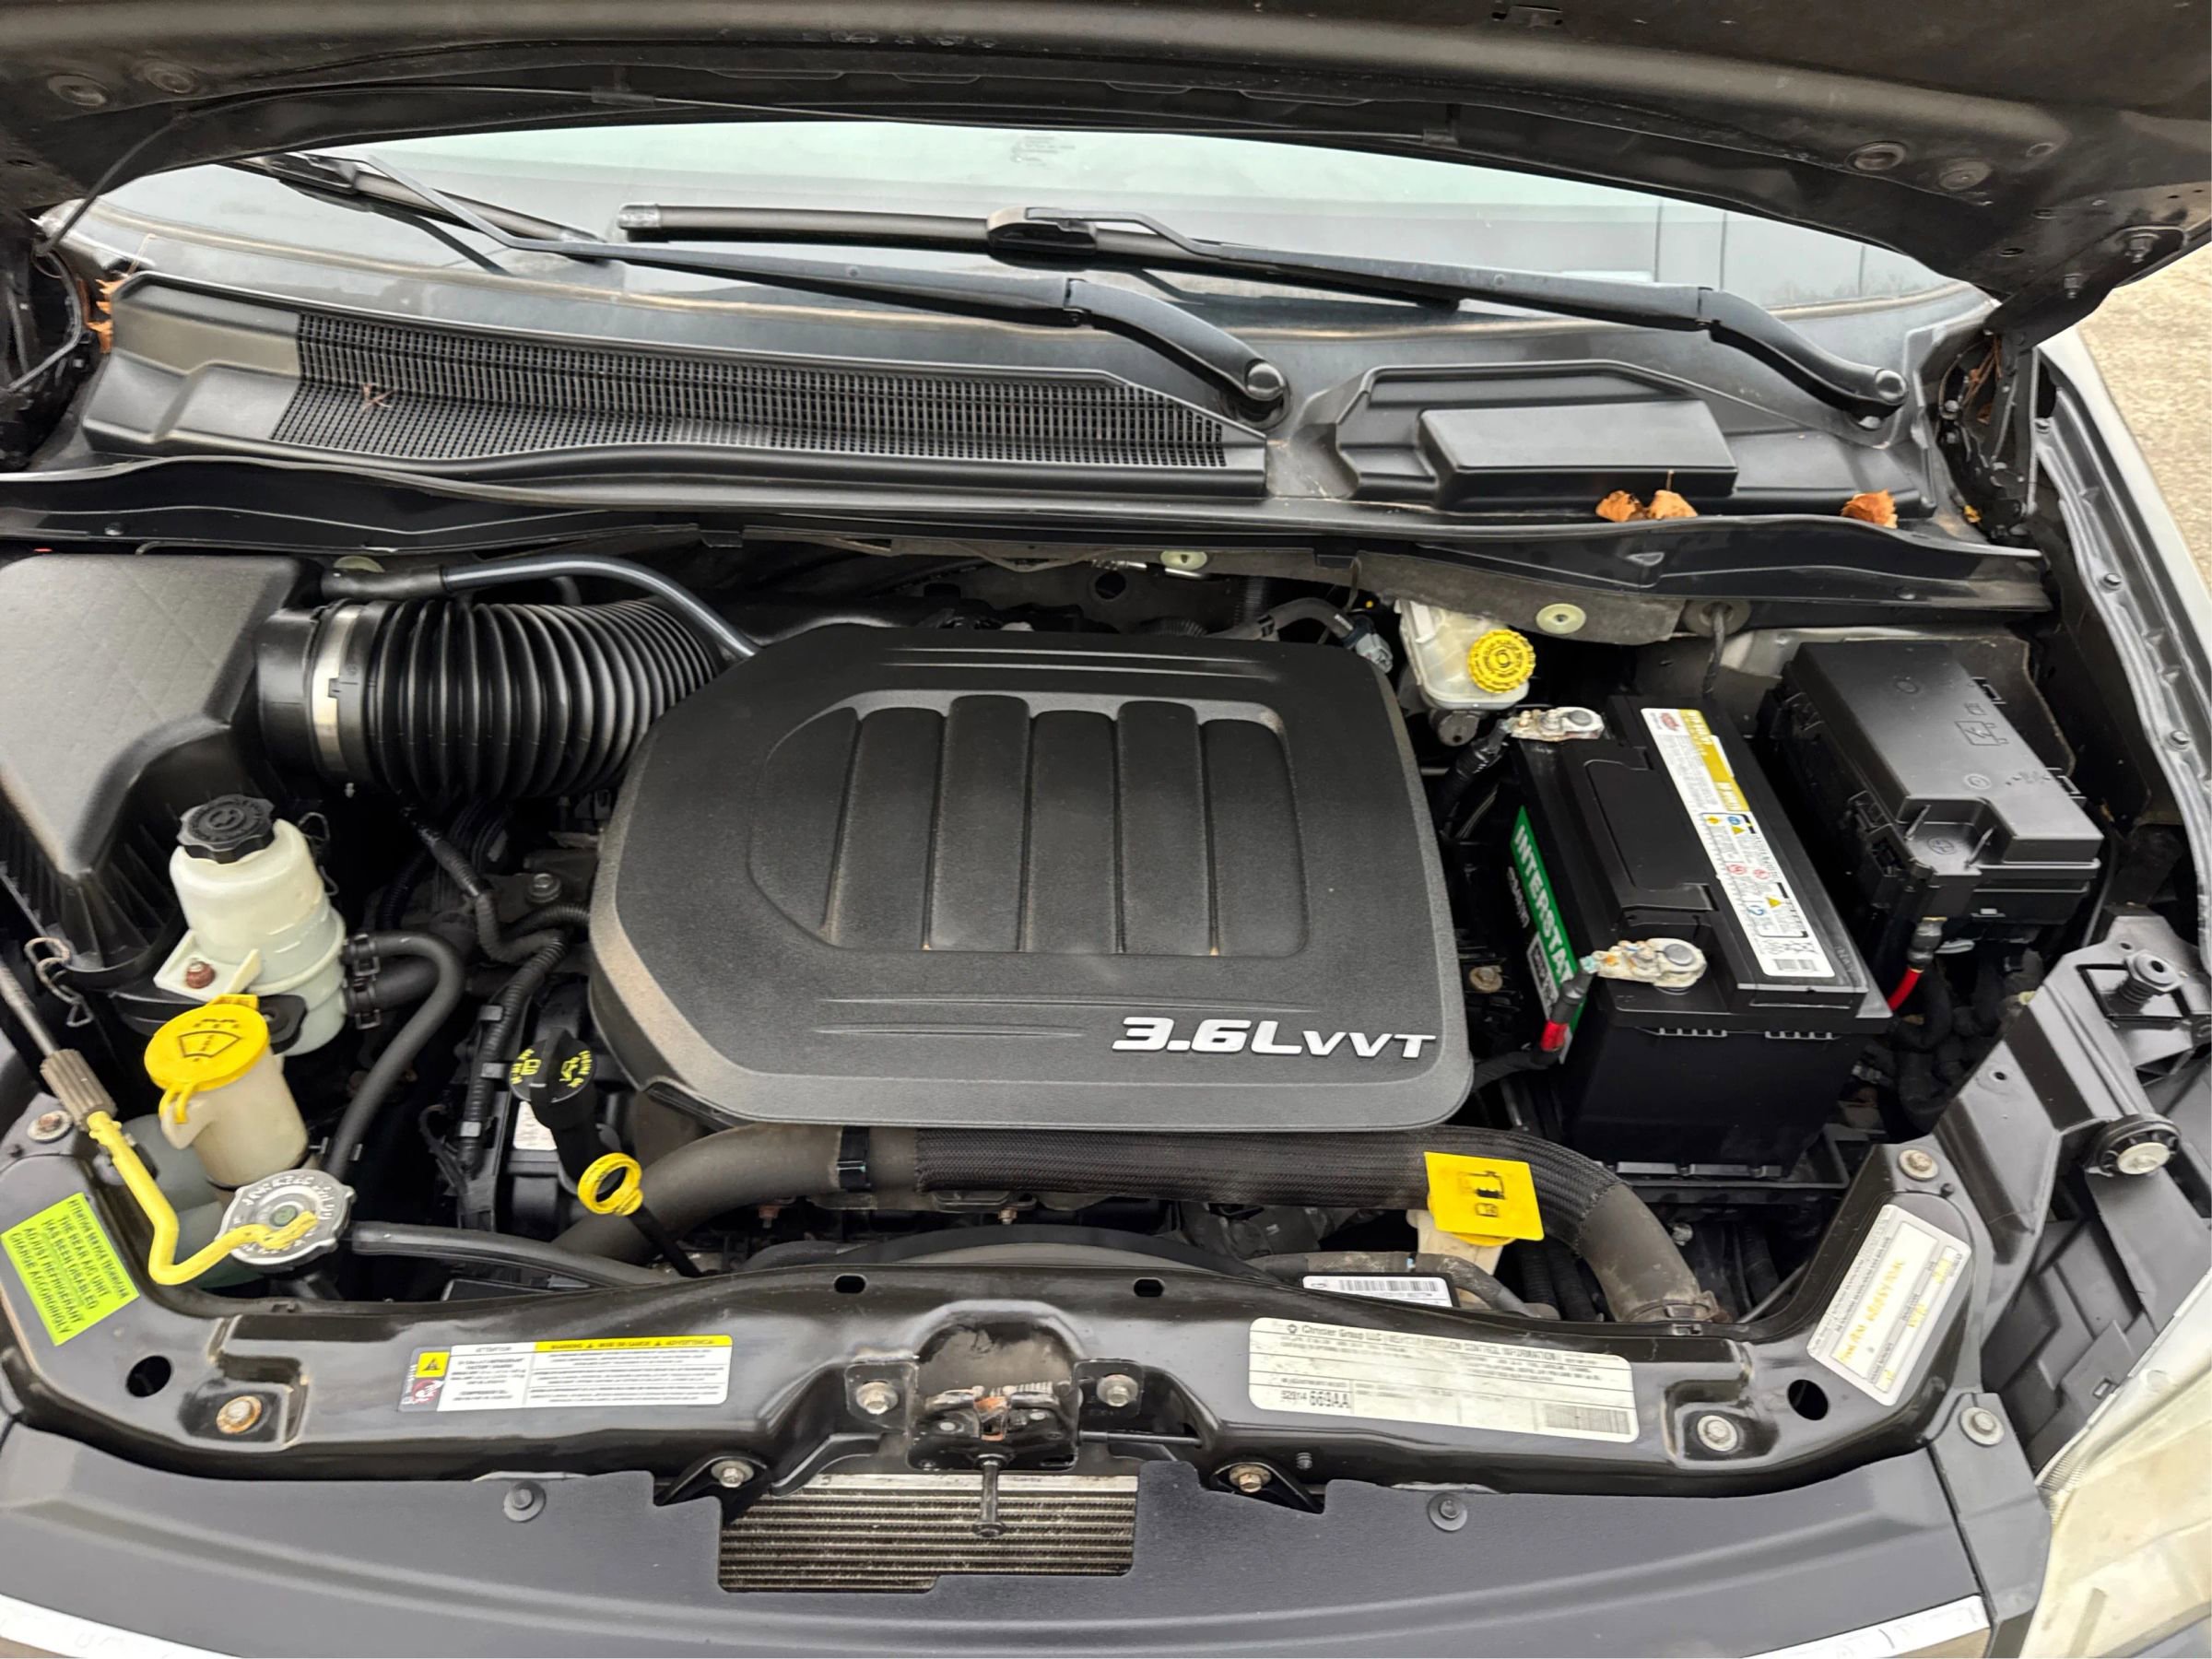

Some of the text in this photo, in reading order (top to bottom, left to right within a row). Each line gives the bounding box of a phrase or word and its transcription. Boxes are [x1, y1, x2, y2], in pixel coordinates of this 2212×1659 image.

[1514, 825, 1575, 986] INTERSTAT
[41, 1218, 62, 1240] HAS
[52, 1238, 75, 1265] BEEN
[57, 1215, 77, 1234] THE
[67, 1232, 89, 1260] REAR
[89, 1275, 112, 1298] UNIT
